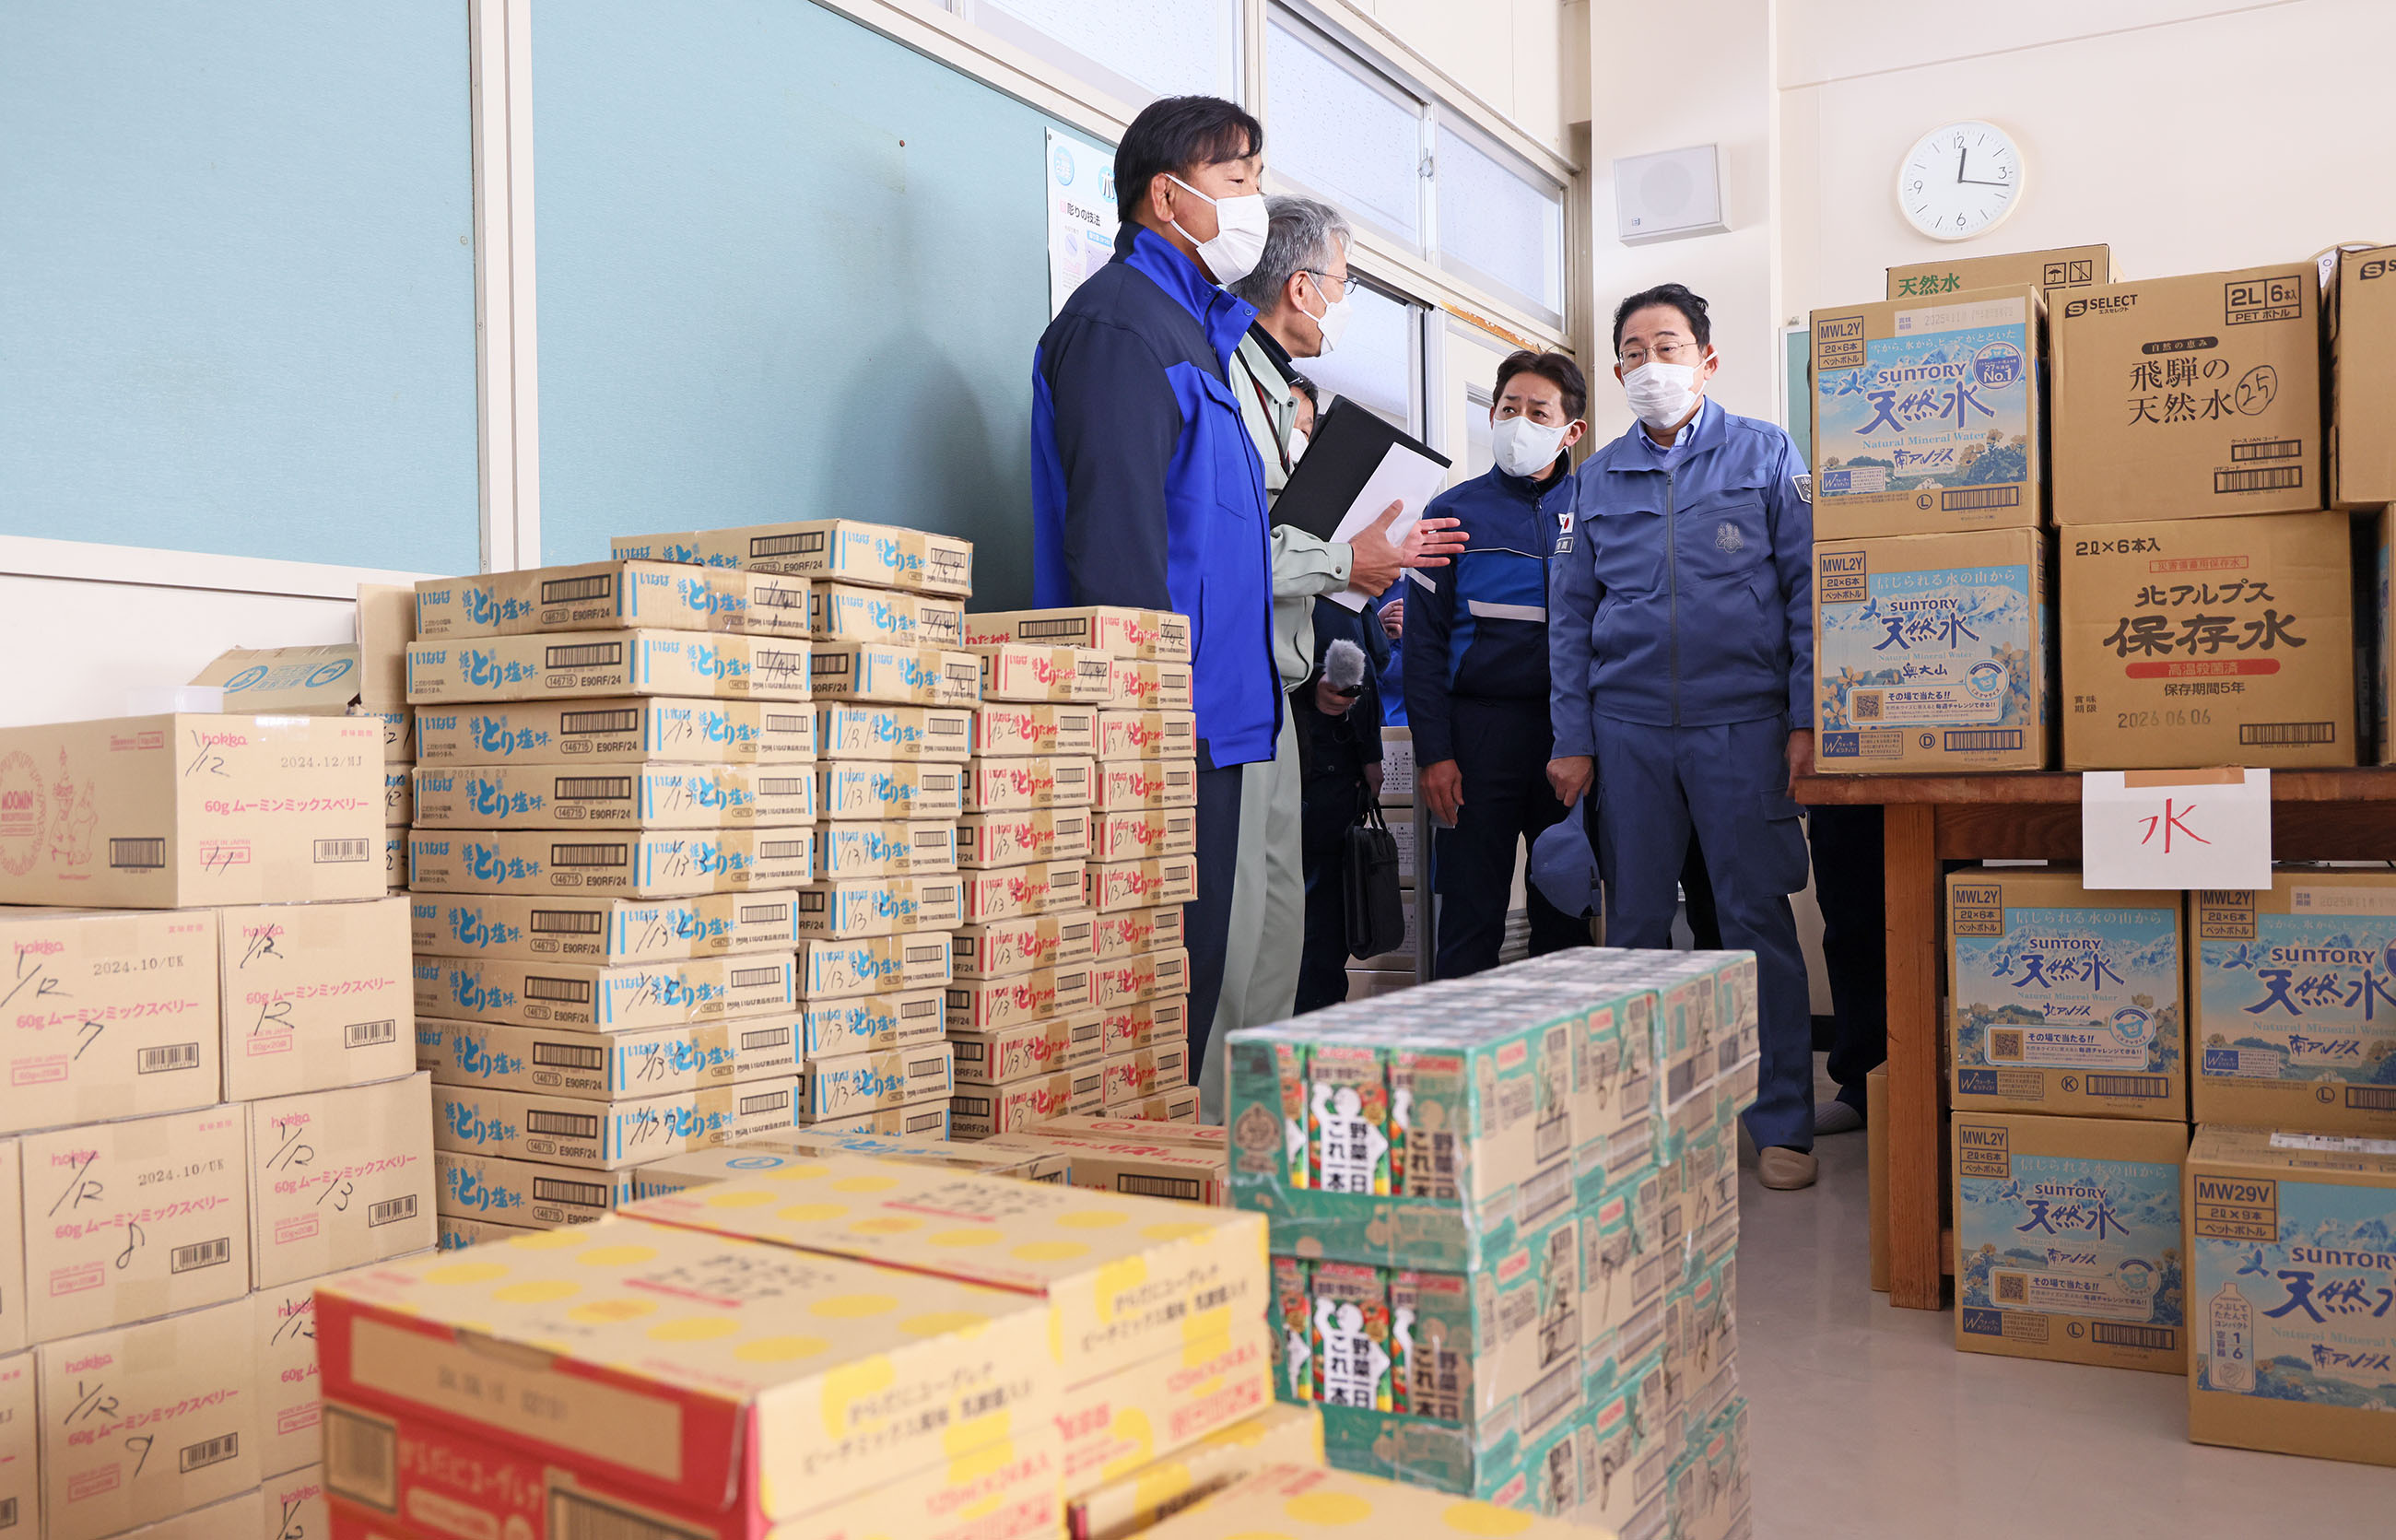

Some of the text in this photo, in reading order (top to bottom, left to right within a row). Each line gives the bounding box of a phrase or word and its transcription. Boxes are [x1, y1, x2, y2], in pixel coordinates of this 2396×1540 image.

[1954, 135, 1965, 148] 12
[1999, 166, 2007, 180] 3
[1914, 180, 1923, 194] 9
[1956, 213, 1966, 226] 6
[1898, 273, 1961, 297] 天然水
[2089, 294, 2138, 310] SELECT
[1820, 323, 1861, 339] MWL2Y
[1823, 355, 1860, 366] ペットボトル
[1879, 363, 1967, 383] SUNTORY
[2129, 358, 2230, 393] 飛騨の
[1855, 382, 1994, 435] 天然水
[2127, 388, 2236, 427] 天然水
[1862, 430, 1987, 450] Natural Mineral Water
[784, 561, 823, 571] E90RF/24
[1822, 558, 1862, 572] MWL2Y
[640, 573, 670, 587] いなば
[1877, 570, 2015, 590] 信じられる水の山から
[422, 590, 452, 605] いなば
[1826, 590, 1862, 599] ペットボトル
[2134, 579, 2274, 608] 北アルプス
[1890, 599, 1958, 611] SUNTORY
[572, 607, 610, 621] E90RF/24
[1873, 612, 1979, 651] 天然水
[2103, 609, 2307, 658] 保存水
[652, 641, 680, 653] いなば
[416, 651, 447, 664] いなば
[1913, 652, 1946, 661] Mineral
[1948, 651, 1974, 659] Water
[2167, 661, 2238, 676] 高温殺菌済
[549, 676, 621, 687] 146715 E90RF/24
[2164, 681, 2246, 697] 保存期間5年
[426, 717, 457, 730] いなば
[2166, 710, 2187, 726] 06
[2190, 708, 2212, 724] 06
[202, 733, 248, 747] hokka
[564, 741, 637, 752] 146715 E90RF/24
[422, 778, 452, 792] いなば
[205, 798, 369, 816] 60g ムーミンミックスベリー
[558, 809, 630, 819] 146715 E90RF/24
[2138, 797, 2213, 854] 水
[419, 841, 450, 855] いなば
[555, 875, 627, 887] 146715 E90RF/24
[1956, 890, 1998, 904] MWL2Y
[2203, 891, 2250, 906] MWL2Y
[1958, 923, 1997, 933] ペットボトル
[2206, 925, 2249, 935] ペットボトル
[14, 940, 65, 956] hokka
[534, 940, 601, 955] 146715 E90RF/24
[2030, 938, 2101, 949] SUNTORY
[2272, 947, 2376, 963] SUNTORY
[2012, 953, 2125, 991] 天然水
[246, 977, 395, 1005] 60g ムーミンミックスベリー
[2242, 970, 2396, 1021] 天然水
[17, 1001, 199, 1030] 60g ムーミンミックスベリー
[528, 1006, 589, 1024] 146715 E90RF/24
[536, 1073, 603, 1090] 146715 E90RF/24
[271, 1111, 311, 1128] hokka
[952, 1123, 990, 1134] E90RF/24
[1963, 1130, 2004, 1146] MWL2Y
[51, 1149, 100, 1167] hokka
[530, 1141, 597, 1160] 146715 E90RF/24
[1327, 1120, 1345, 1190] これ一本
[275, 1154, 417, 1195] 60g ムーミンミックスベリー
[1966, 1164, 2003, 1174] ペットボトル
[2035, 1184, 2107, 1198] SUNTORY
[2200, 1182, 2270, 1203] MW29V
[55, 1196, 229, 1239] 60g ムーミンミックスベリー
[2016, 1199, 2130, 1240] 天然水
[2205, 1224, 2266, 1237] ペットボトル
[65, 1352, 113, 1373] hokka
[68, 1388, 239, 1446] 60g ムーミンミックスベリー
